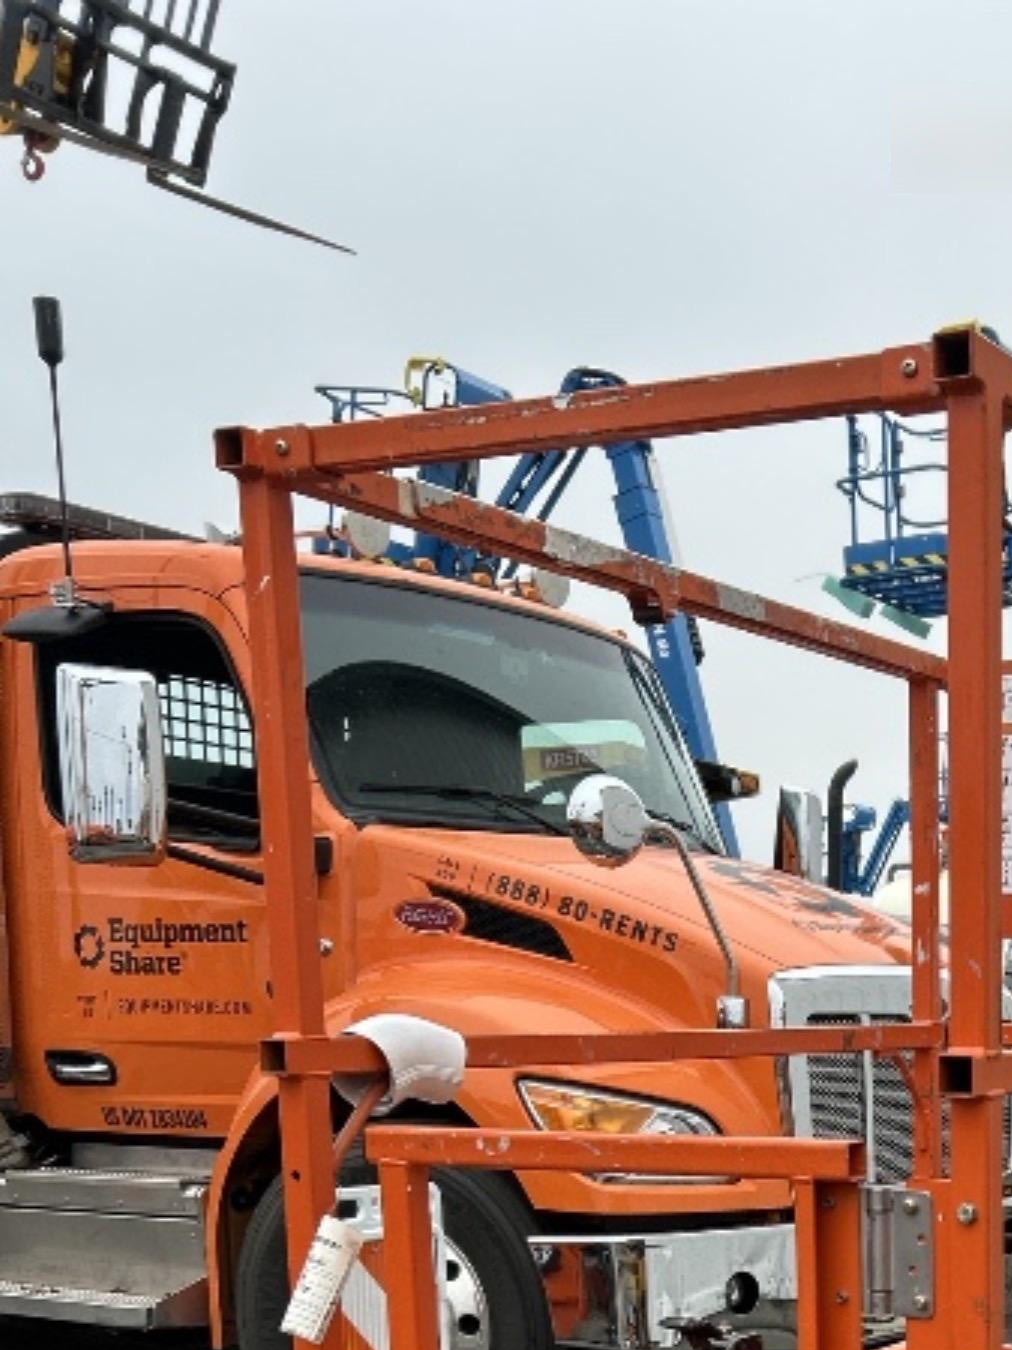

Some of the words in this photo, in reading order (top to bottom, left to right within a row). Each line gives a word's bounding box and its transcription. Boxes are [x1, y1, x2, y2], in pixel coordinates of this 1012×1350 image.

[486, 872, 550, 909] (888)
[557, 896, 679, 952] 80-RENTS
[107, 918, 248, 948] Equipment
[110, 951, 181, 975] Share
